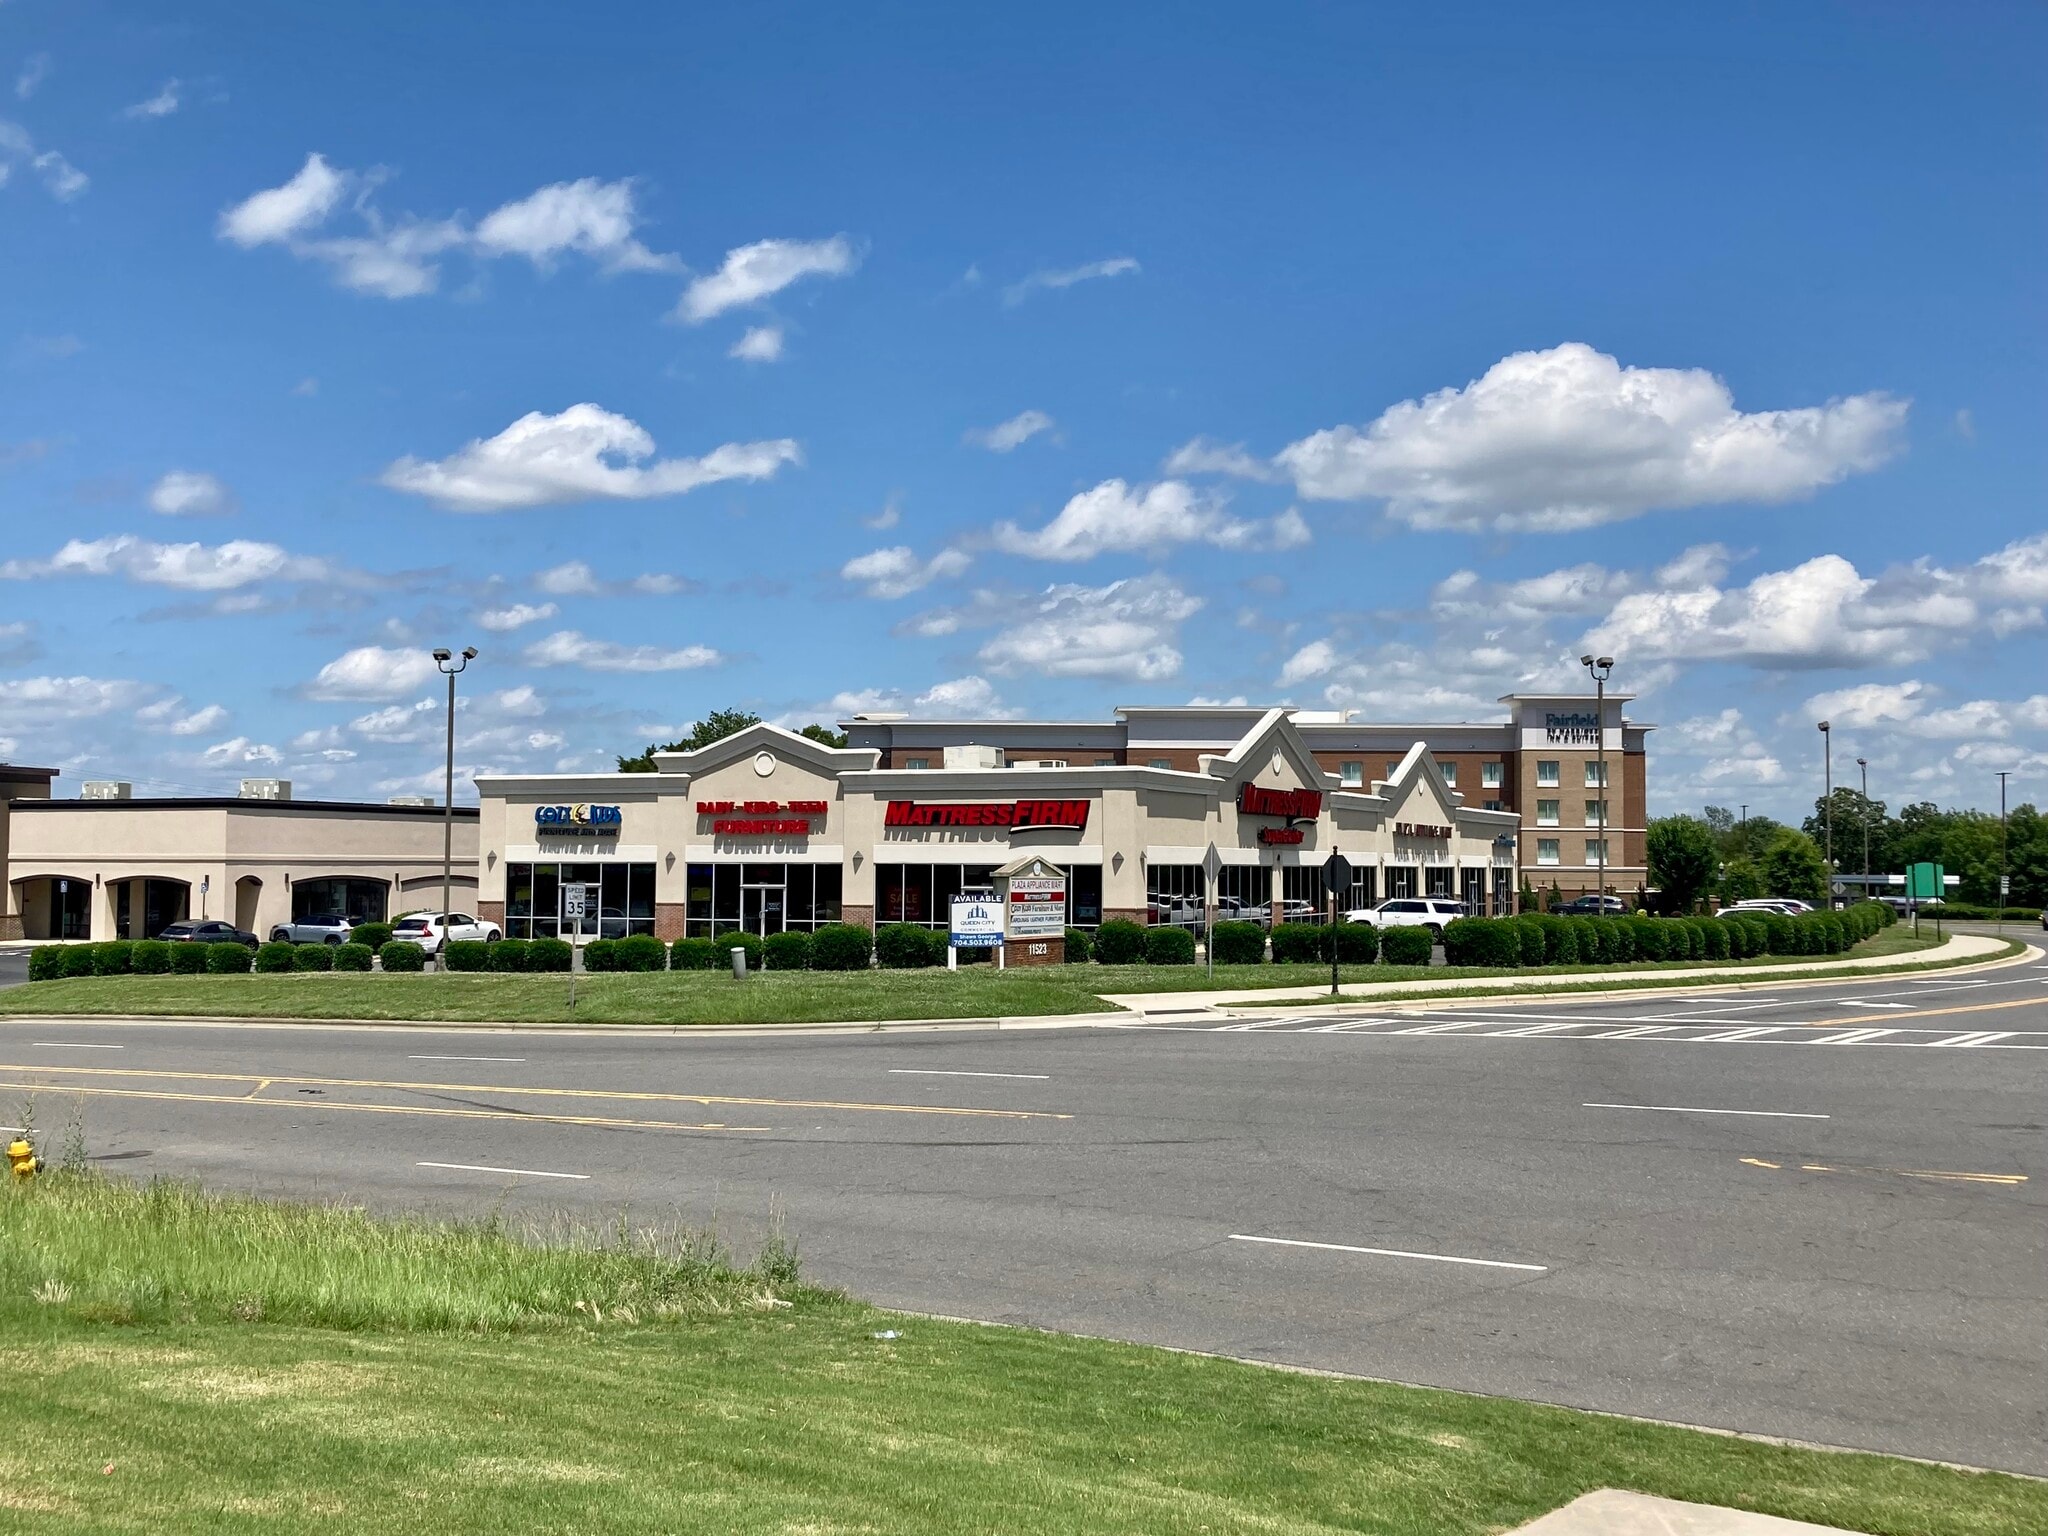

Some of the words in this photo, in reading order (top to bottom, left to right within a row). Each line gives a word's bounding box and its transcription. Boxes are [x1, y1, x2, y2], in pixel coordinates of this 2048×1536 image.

[1545, 713, 1599, 727] Fairfield
[535, 805, 572, 825] COZY
[714, 820, 810, 835] FURNITURE
[1012, 881, 1026, 889] PLAZA
[1027, 881, 1051, 889] APPLIANCE
[1051, 881, 1063, 889] MART
[889, 893, 918, 904] SALE
[567, 902, 584, 914] 35
[1028, 943, 1047, 955] 11523
